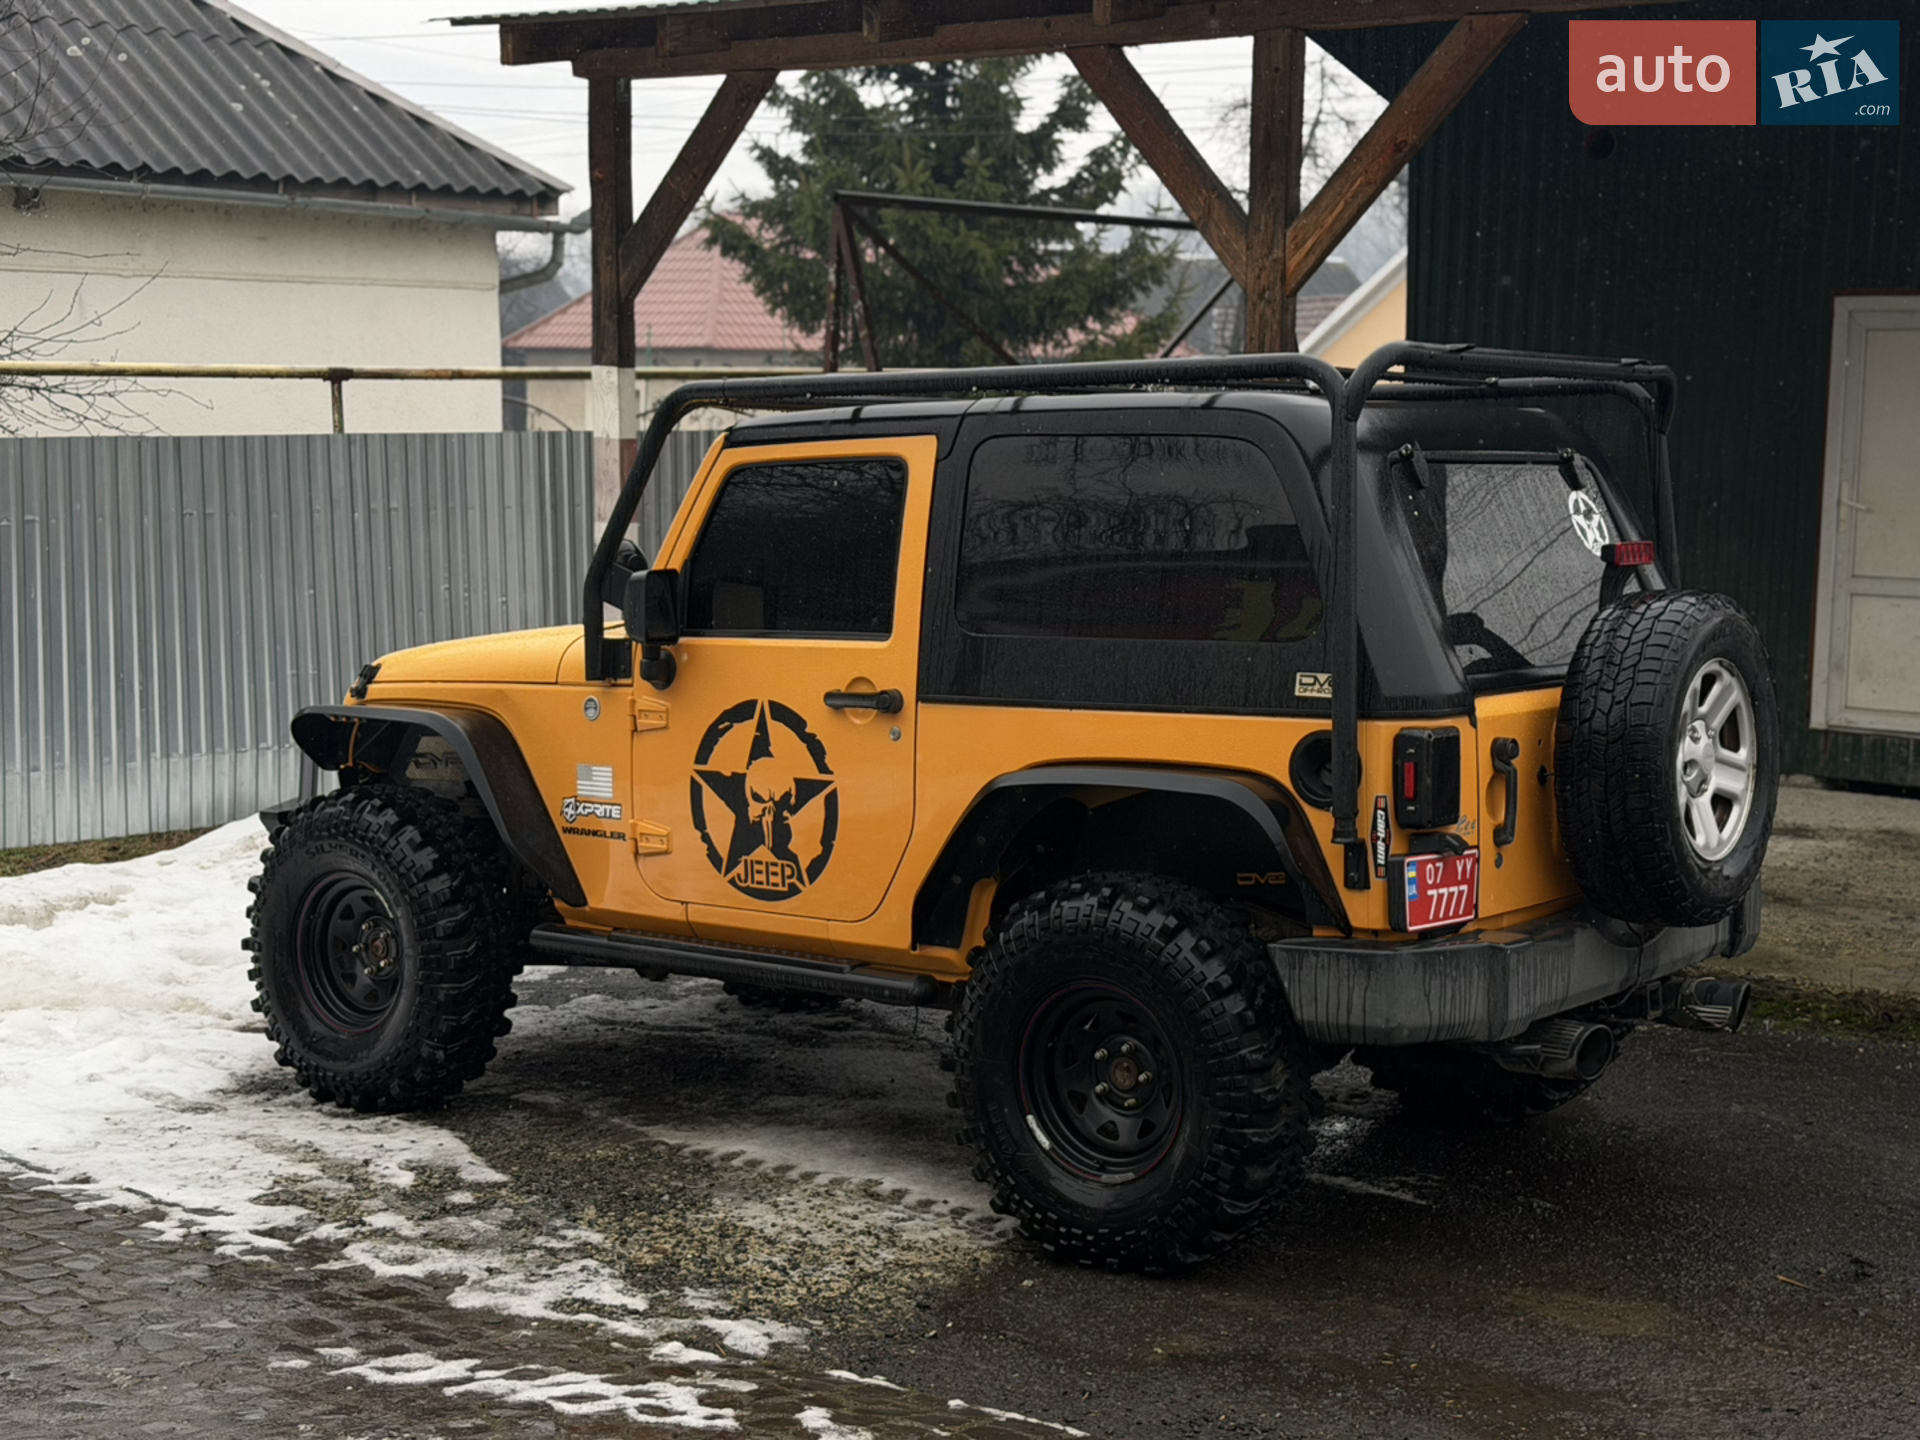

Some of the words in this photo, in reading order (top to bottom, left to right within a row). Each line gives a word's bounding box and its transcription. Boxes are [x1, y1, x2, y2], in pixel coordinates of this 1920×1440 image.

[1299, 674, 1332, 688] DV
[576, 802, 622, 818] XPRITE
[562, 826, 627, 841] WRANGLER
[735, 858, 798, 889] JEEP
[1426, 863, 1444, 885] 07
[1456, 857, 1473, 881] YY
[1427, 884, 1469, 920] 7777
